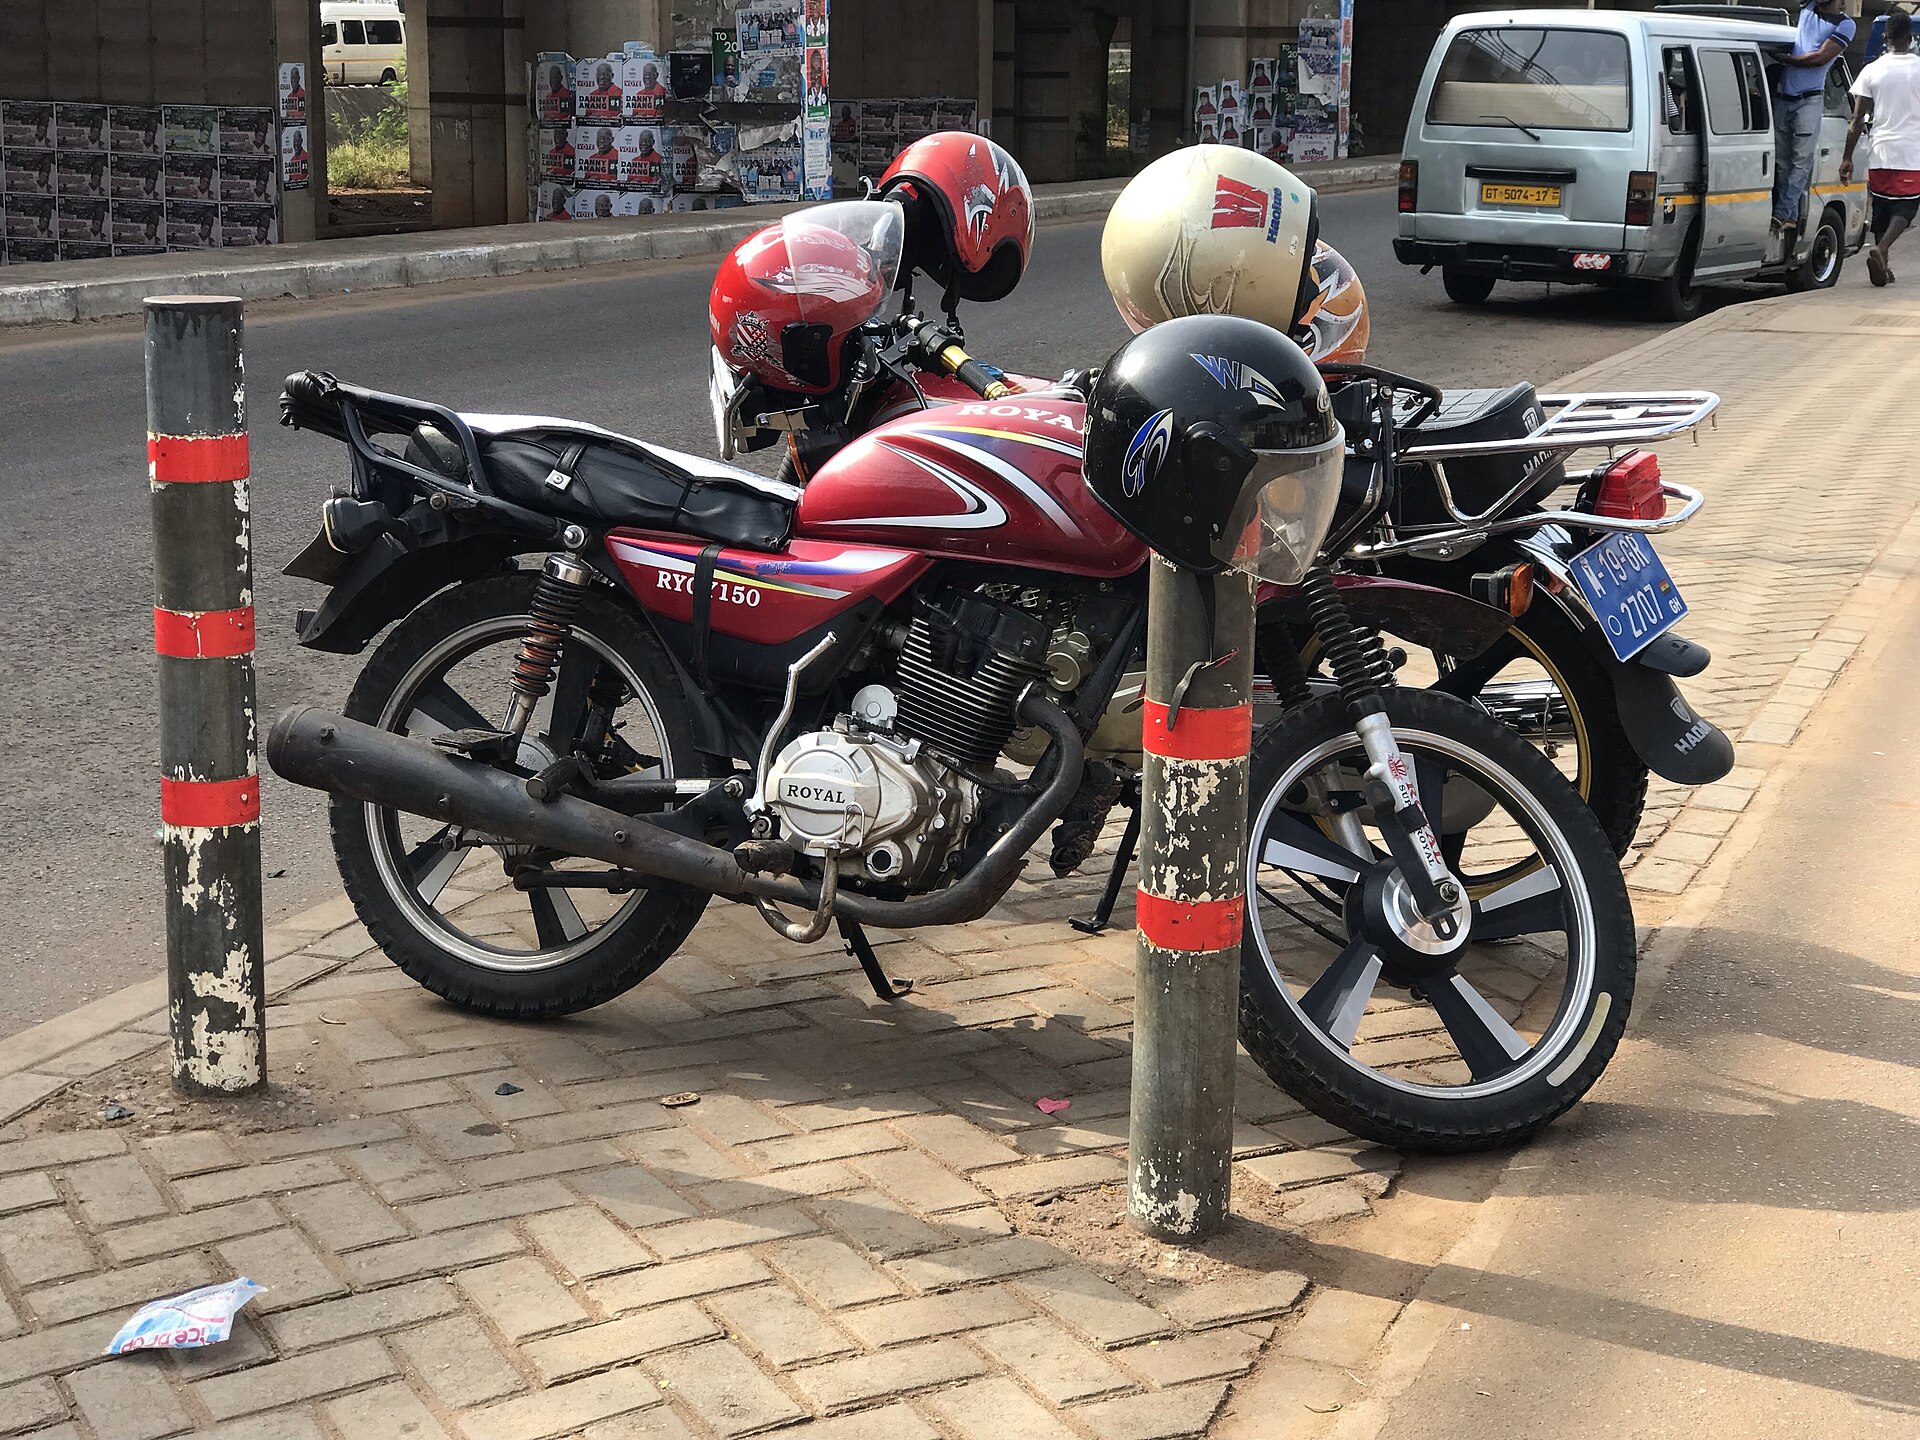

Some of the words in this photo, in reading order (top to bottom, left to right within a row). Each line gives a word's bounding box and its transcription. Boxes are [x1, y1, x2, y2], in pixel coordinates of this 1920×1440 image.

[715, 32, 726, 40] TO
[1486, 188, 1498, 199] GT
[1504, 190, 1548, 202] 5074-17
[956, 404, 1085, 434] ROYA
[1620, 584, 1664, 638] 2707
[1668, 596, 1683, 614] GH
[787, 784, 846, 804] ROYAL
